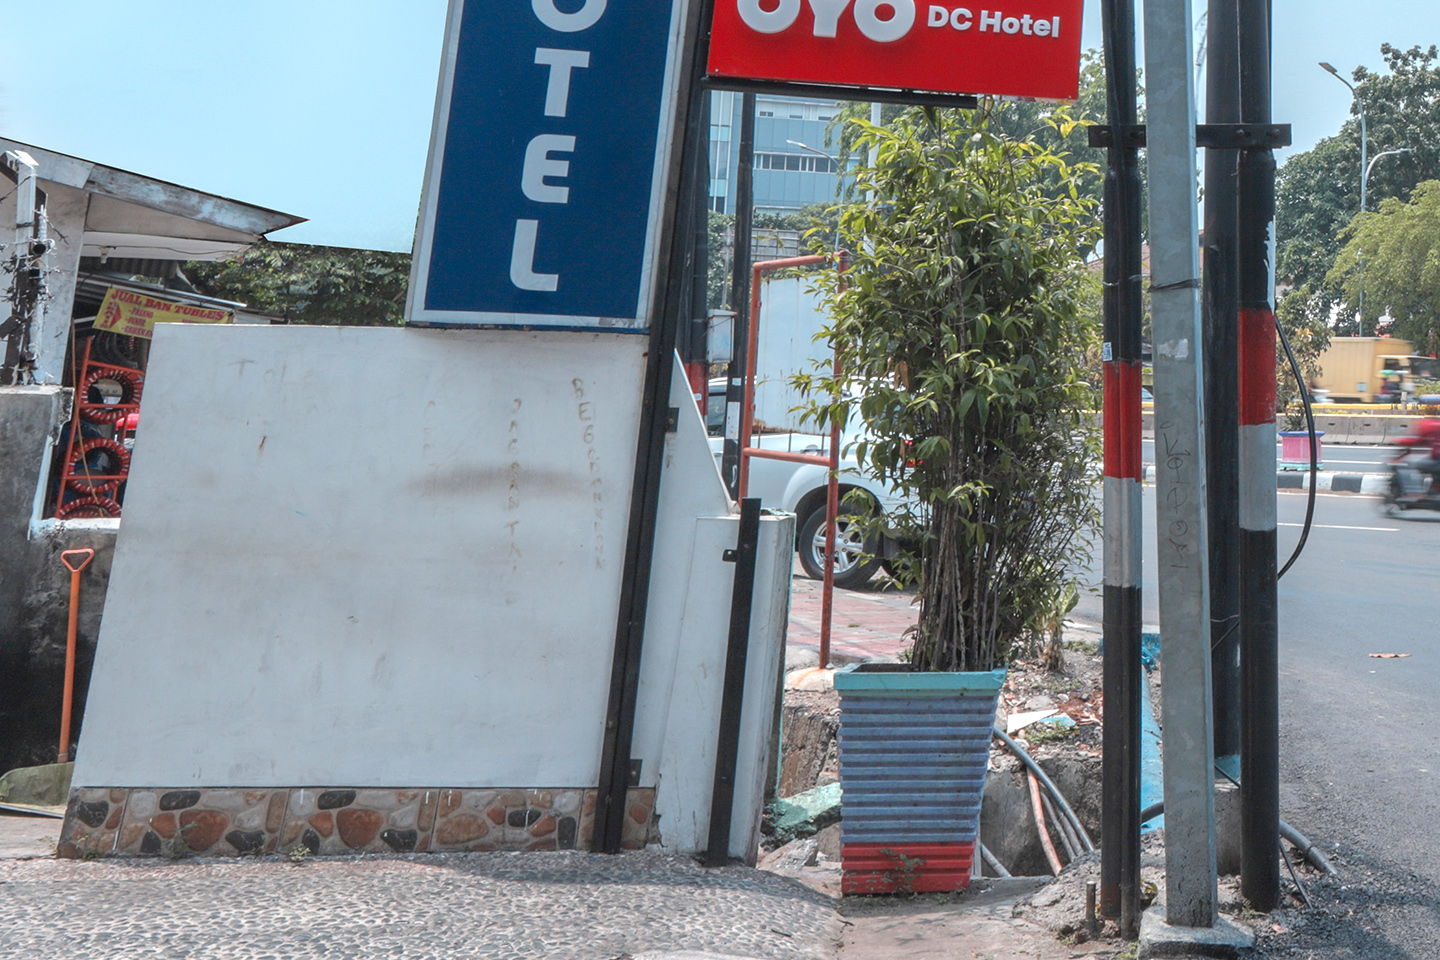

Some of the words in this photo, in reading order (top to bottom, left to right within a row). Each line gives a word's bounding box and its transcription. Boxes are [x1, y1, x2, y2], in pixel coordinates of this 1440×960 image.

[927, 4, 973, 31] DC
[979, 9, 1061, 39] Hotel
[111, 289, 142, 306] JUAL
[145, 298, 172, 311] BAN
[175, 305, 225, 320] TUBLES
